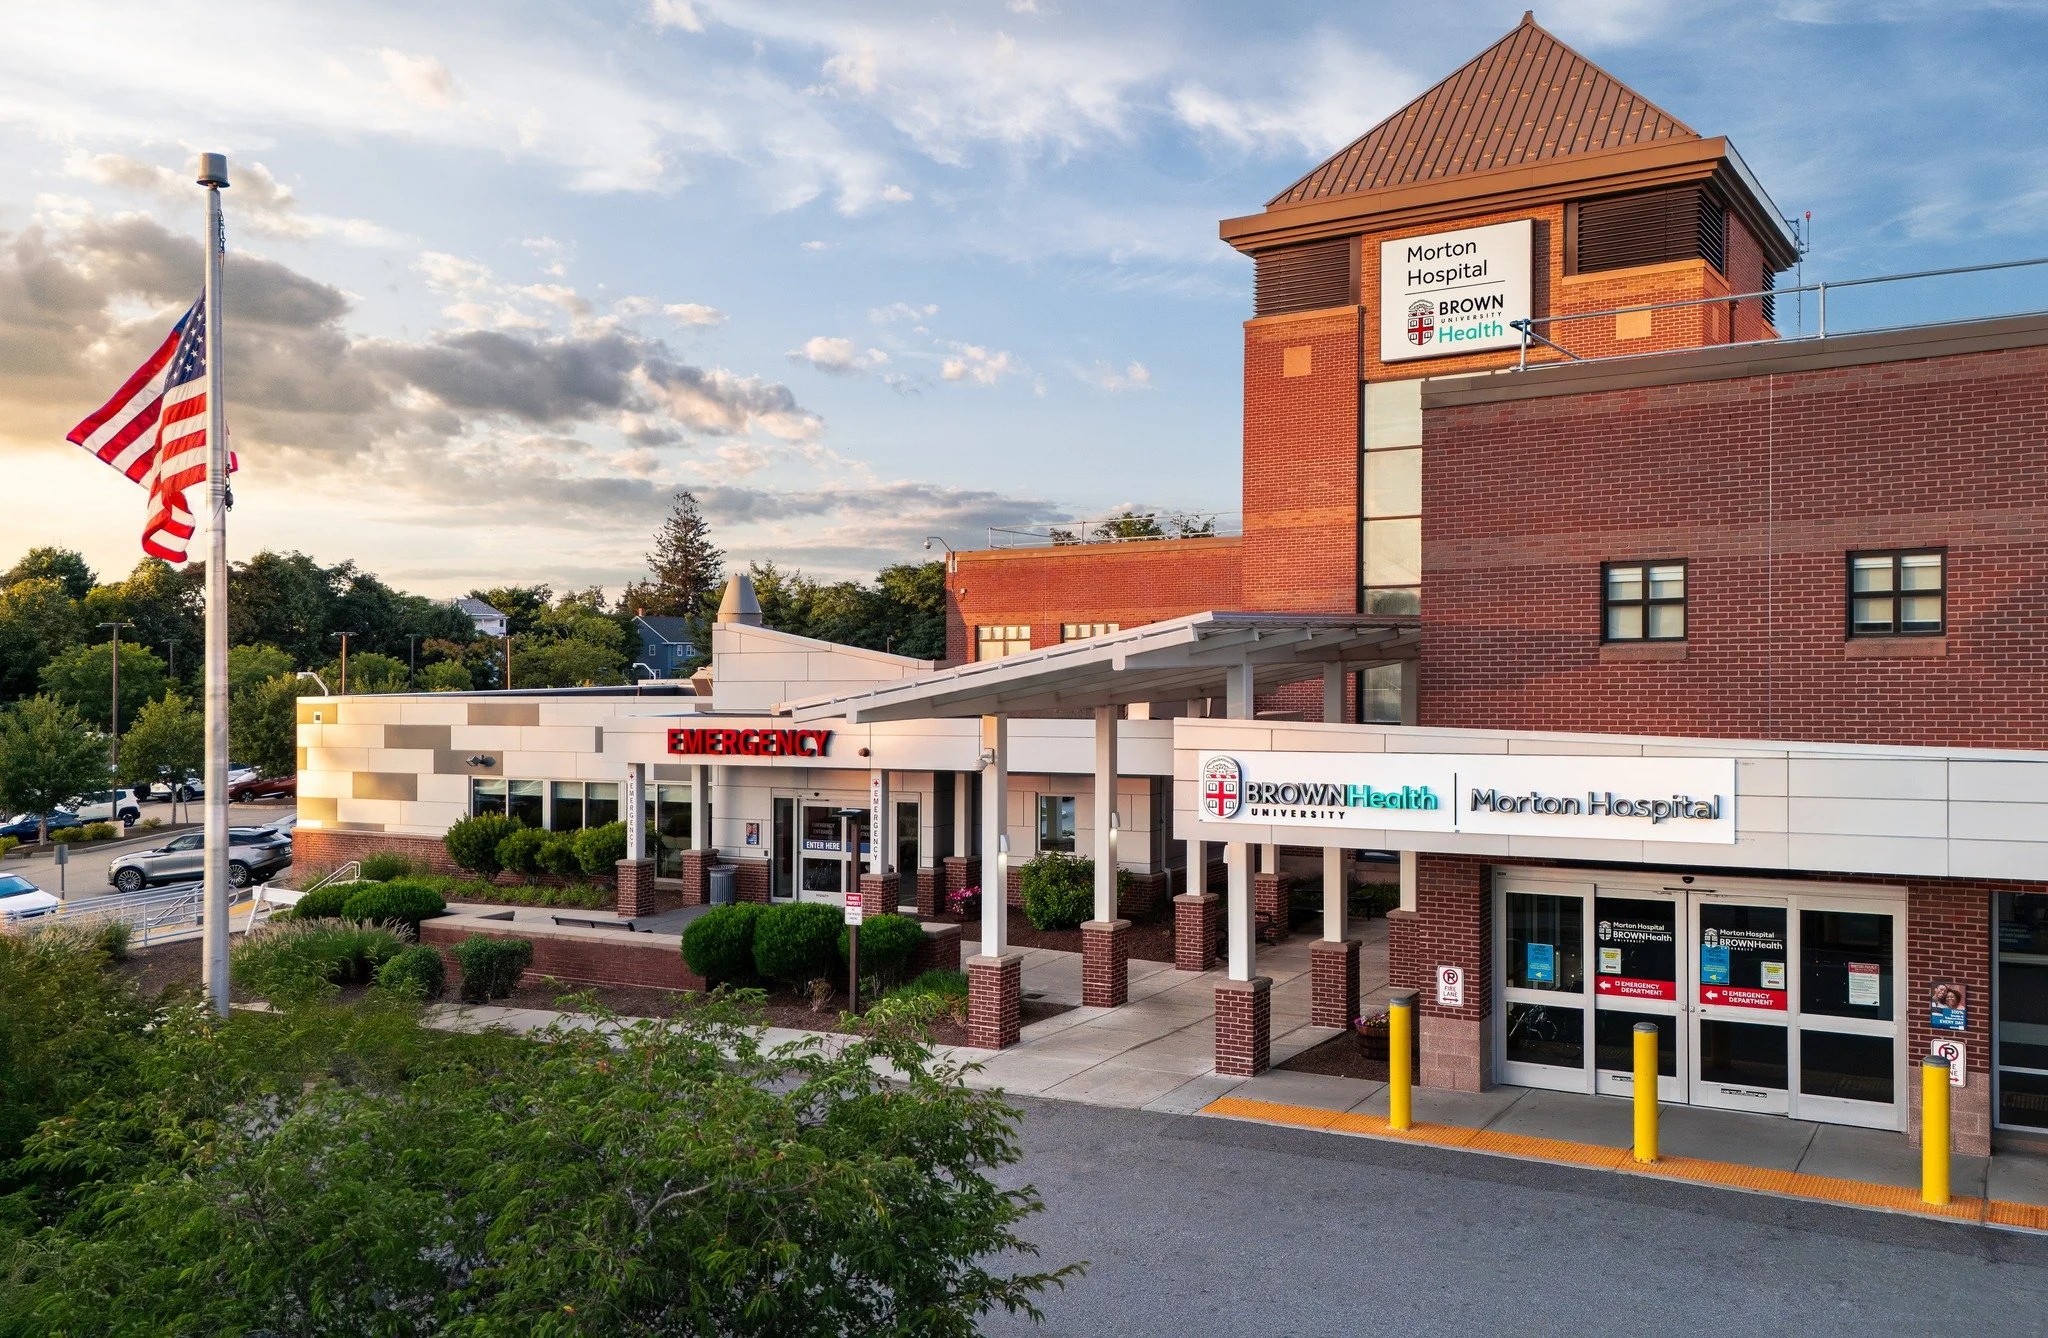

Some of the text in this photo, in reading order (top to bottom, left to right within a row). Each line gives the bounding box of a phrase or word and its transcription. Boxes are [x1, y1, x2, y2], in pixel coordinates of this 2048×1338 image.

[1408, 242, 1476, 263] Morton
[1408, 259, 1487, 286] Hospital
[1439, 294, 1504, 315] BROWN
[1441, 312, 1502, 323] UNIVERSITY
[1439, 320, 1503, 343] Health
[668, 729, 829, 757] EMERGENCY
[1251, 808, 1345, 819] UNIVERSITY
[1471, 788, 1720, 824] Morton Hospital
[806, 841, 840, 850] ENTER HERE
[1621, 988, 1663, 996] DEPARTMENT
[1729, 990, 1770, 999] EMERGENCY
